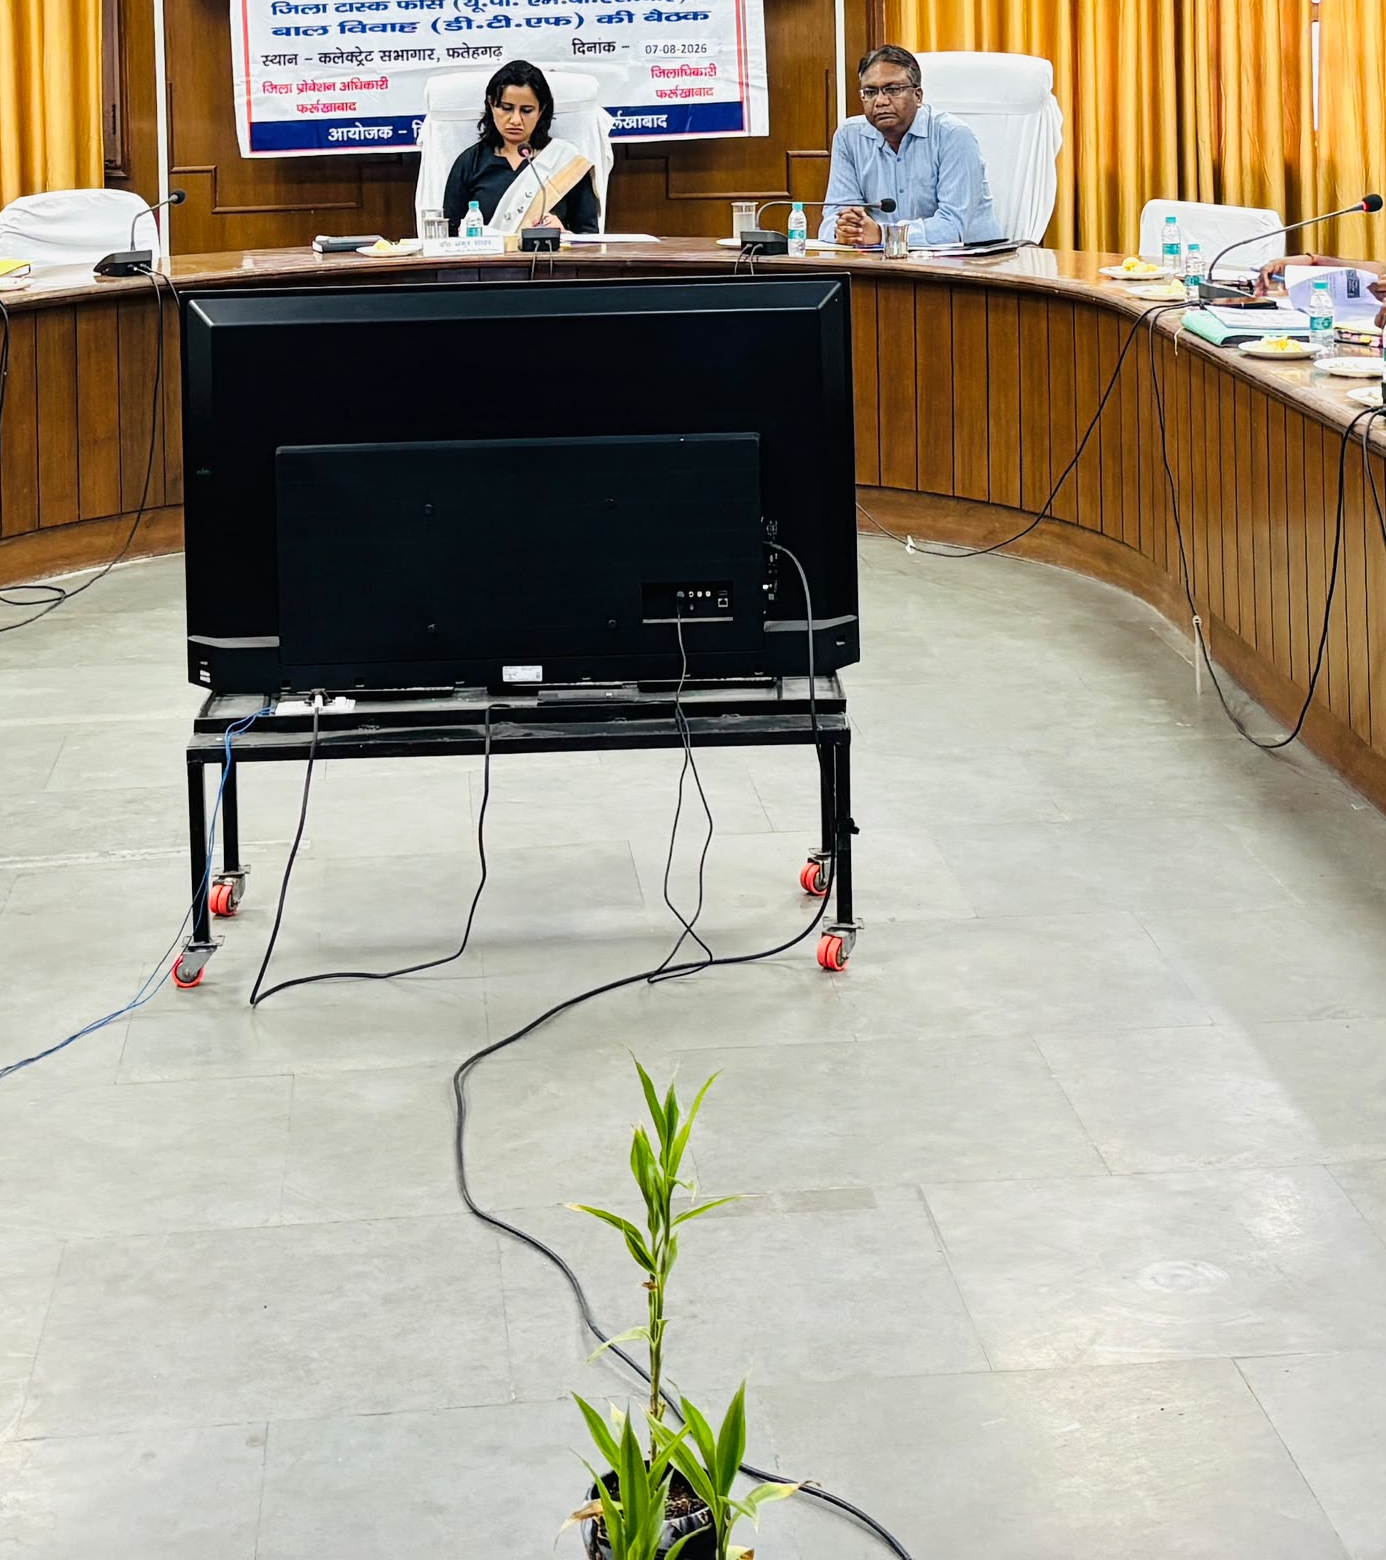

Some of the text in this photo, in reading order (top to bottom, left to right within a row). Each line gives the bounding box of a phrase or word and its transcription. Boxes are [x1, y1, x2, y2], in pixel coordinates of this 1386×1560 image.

[271, 1, 328, 16] जिला
[334, 1, 390, 13] टास्क
[338, 19, 420, 35] विवाह
[595, 9, 636, 25] की
[642, 8, 712, 23] बैठक
[261, 54, 299, 67] स्थान
[317, 46, 375, 67] कलेक्ट्रेट
[378, 48, 440, 63] सभागार,
[446, 42, 503, 61] फतेहगढ़
[572, 37, 616, 55] दिनांक
[645, 43, 707, 55] 07-08-2026
[651, 63, 717, 79] जिलाधिकारी
[262, 80, 292, 95] जिला
[339, 76, 389, 92] अधिकारी
[328, 122, 393, 142] आयोजक
